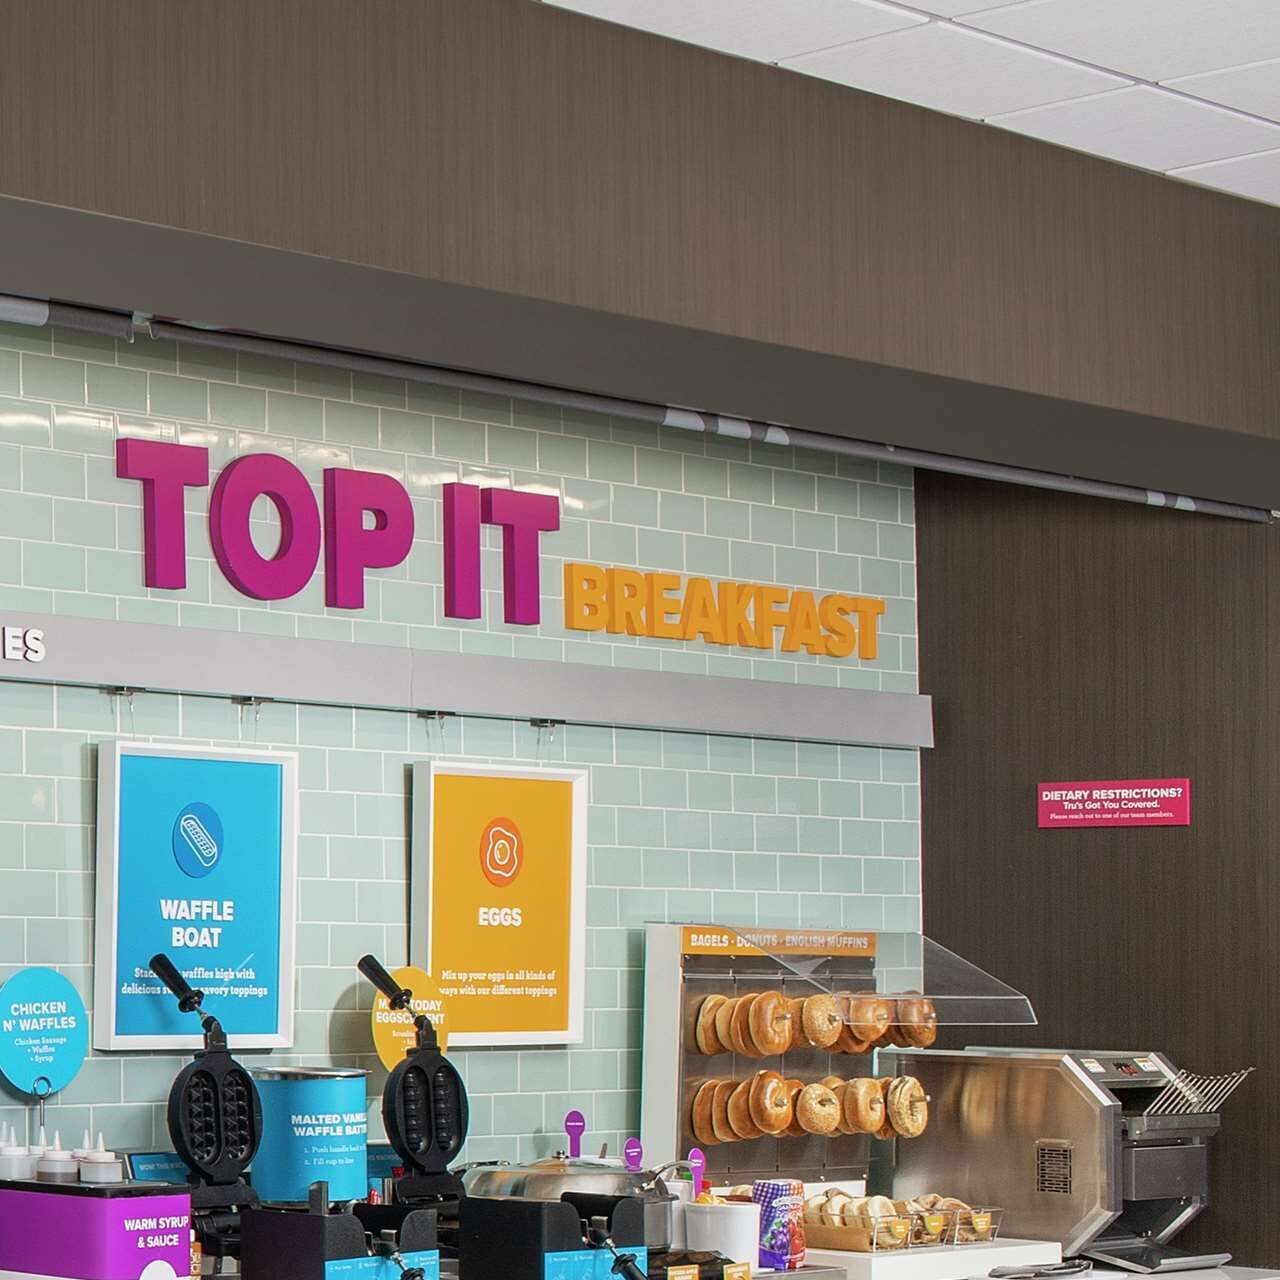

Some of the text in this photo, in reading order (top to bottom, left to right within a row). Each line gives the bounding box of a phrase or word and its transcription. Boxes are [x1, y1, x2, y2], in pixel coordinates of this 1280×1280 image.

[116, 438, 561, 625] TOP IT
[564, 561, 885, 659] BREAKFAST
[1043, 788, 1182, 801] DIETARY RESTRICTIONS?
[1063, 800, 1160, 810] Tru's Got You Covered.
[160, 899, 234, 921] WAFFLE
[479, 907, 522, 927] EGGS
[171, 927, 222, 948] BOAT
[691, 934, 869, 949] BAGELS DONUTS ENGLISH MUFFINS
[182, 968, 214, 979] waffles
[215, 968, 234, 981] high
[235, 968, 255, 979] with
[442, 970, 555, 983] Mix up your eggs in all kinds of
[121, 982, 160, 994] delicious
[230, 986, 268, 1000] toppings
[459, 985, 476, 995] with
[478, 987, 490, 995] our
[492, 985, 524, 995] different
[525, 986, 557, 997] toppings
[11, 1001, 66, 1016] CHICKEN
[3, 1016, 76, 1032] N' WAFFLES
[41, 1037, 66, 1045] Sausage
[32, 1045, 55, 1053] Waffles
[35, 1055, 53, 1063] Syrup
[291, 1114, 340, 1124] MALTED
[293, 1126, 342, 1136] WAFFLE
[312, 1145, 328, 1153] Push
[124, 1216, 188, 1231] WARM SYRUP
[137, 1235, 179, 1248] & SAUCE
